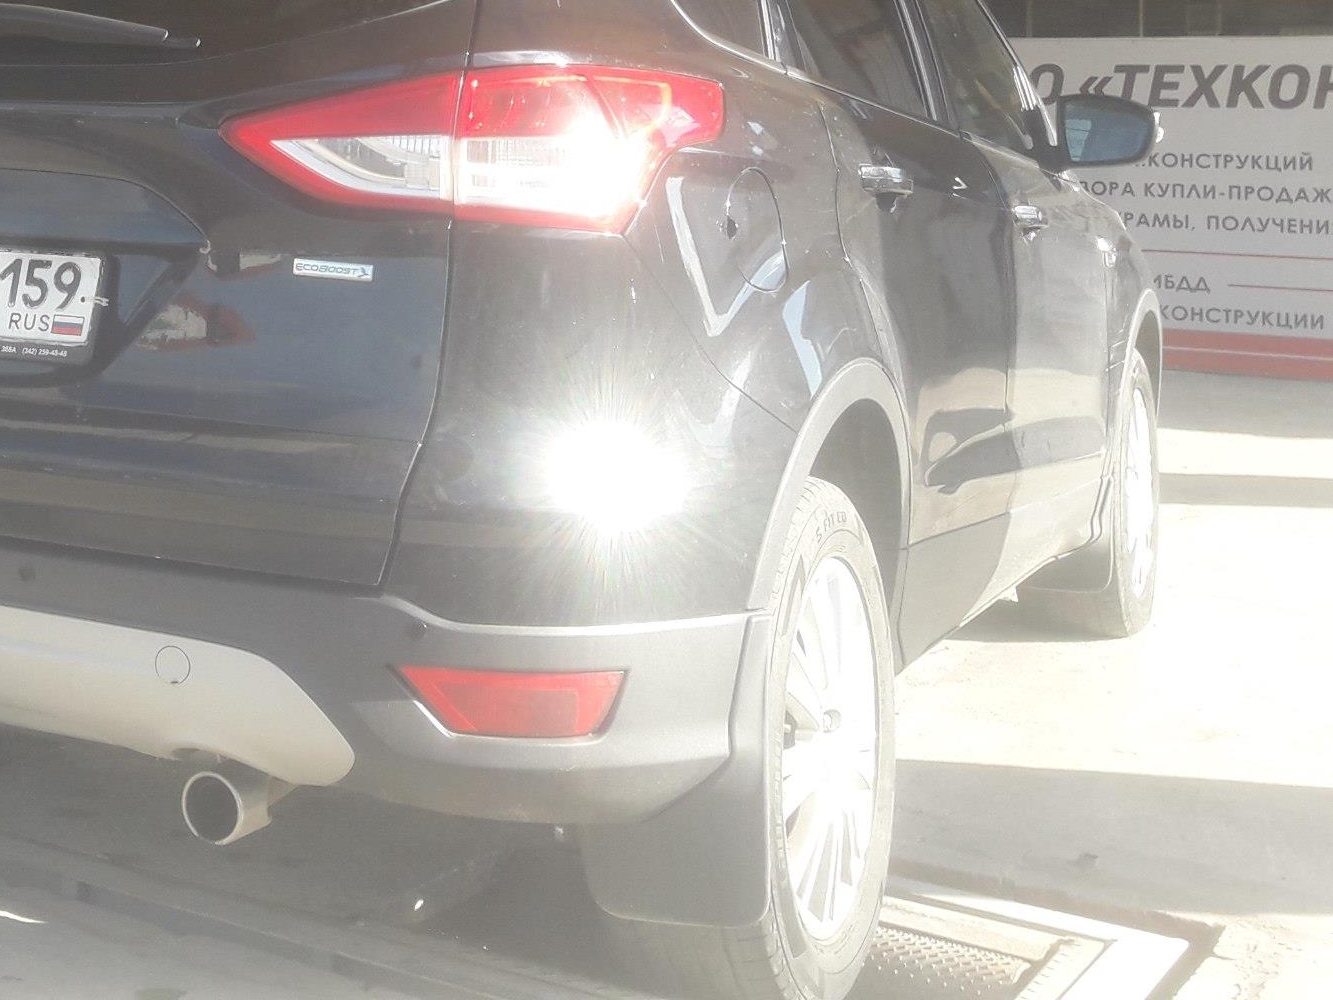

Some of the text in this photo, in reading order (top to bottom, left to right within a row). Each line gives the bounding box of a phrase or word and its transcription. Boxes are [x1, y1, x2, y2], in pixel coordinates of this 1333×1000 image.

[1147, 152, 1314, 172] КОНСТРУКЦИЙ
[295, 263, 358, 276] ECOBOOST
[0, 259, 83, 310] 159
[9, 312, 50, 332] RUS
